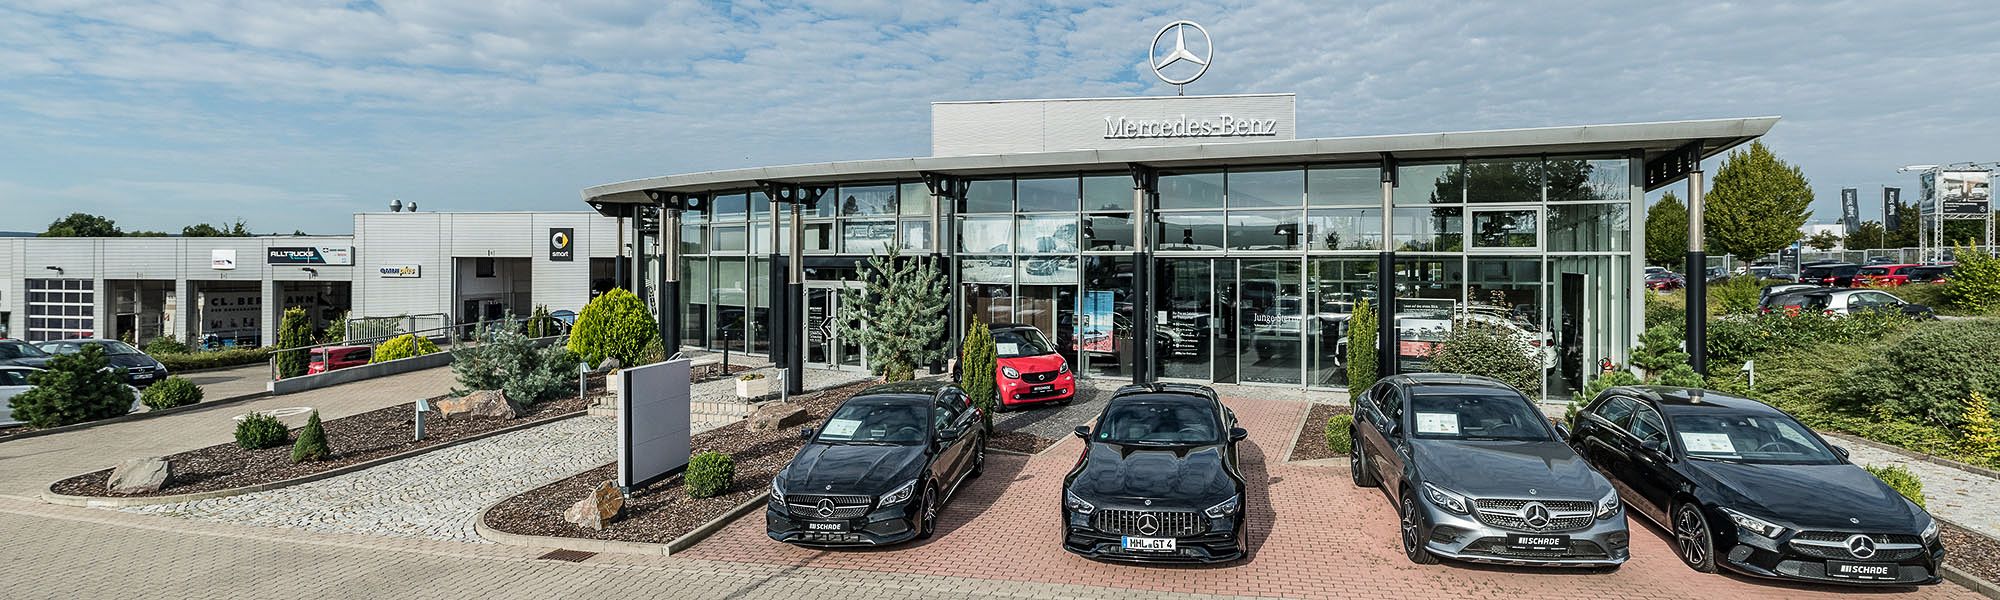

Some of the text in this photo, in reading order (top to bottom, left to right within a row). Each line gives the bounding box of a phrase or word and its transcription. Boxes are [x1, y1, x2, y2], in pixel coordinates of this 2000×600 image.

[1104, 114, 1276, 138] Mercedes-Benz
[270, 250, 314, 258] ALLTRUCKS
[1254, 313, 1276, 324] Junge
[1167, 540, 1172, 548] 4
[1528, 537, 1560, 545] SCHADE
[1852, 565, 1888, 575] SCHADE
